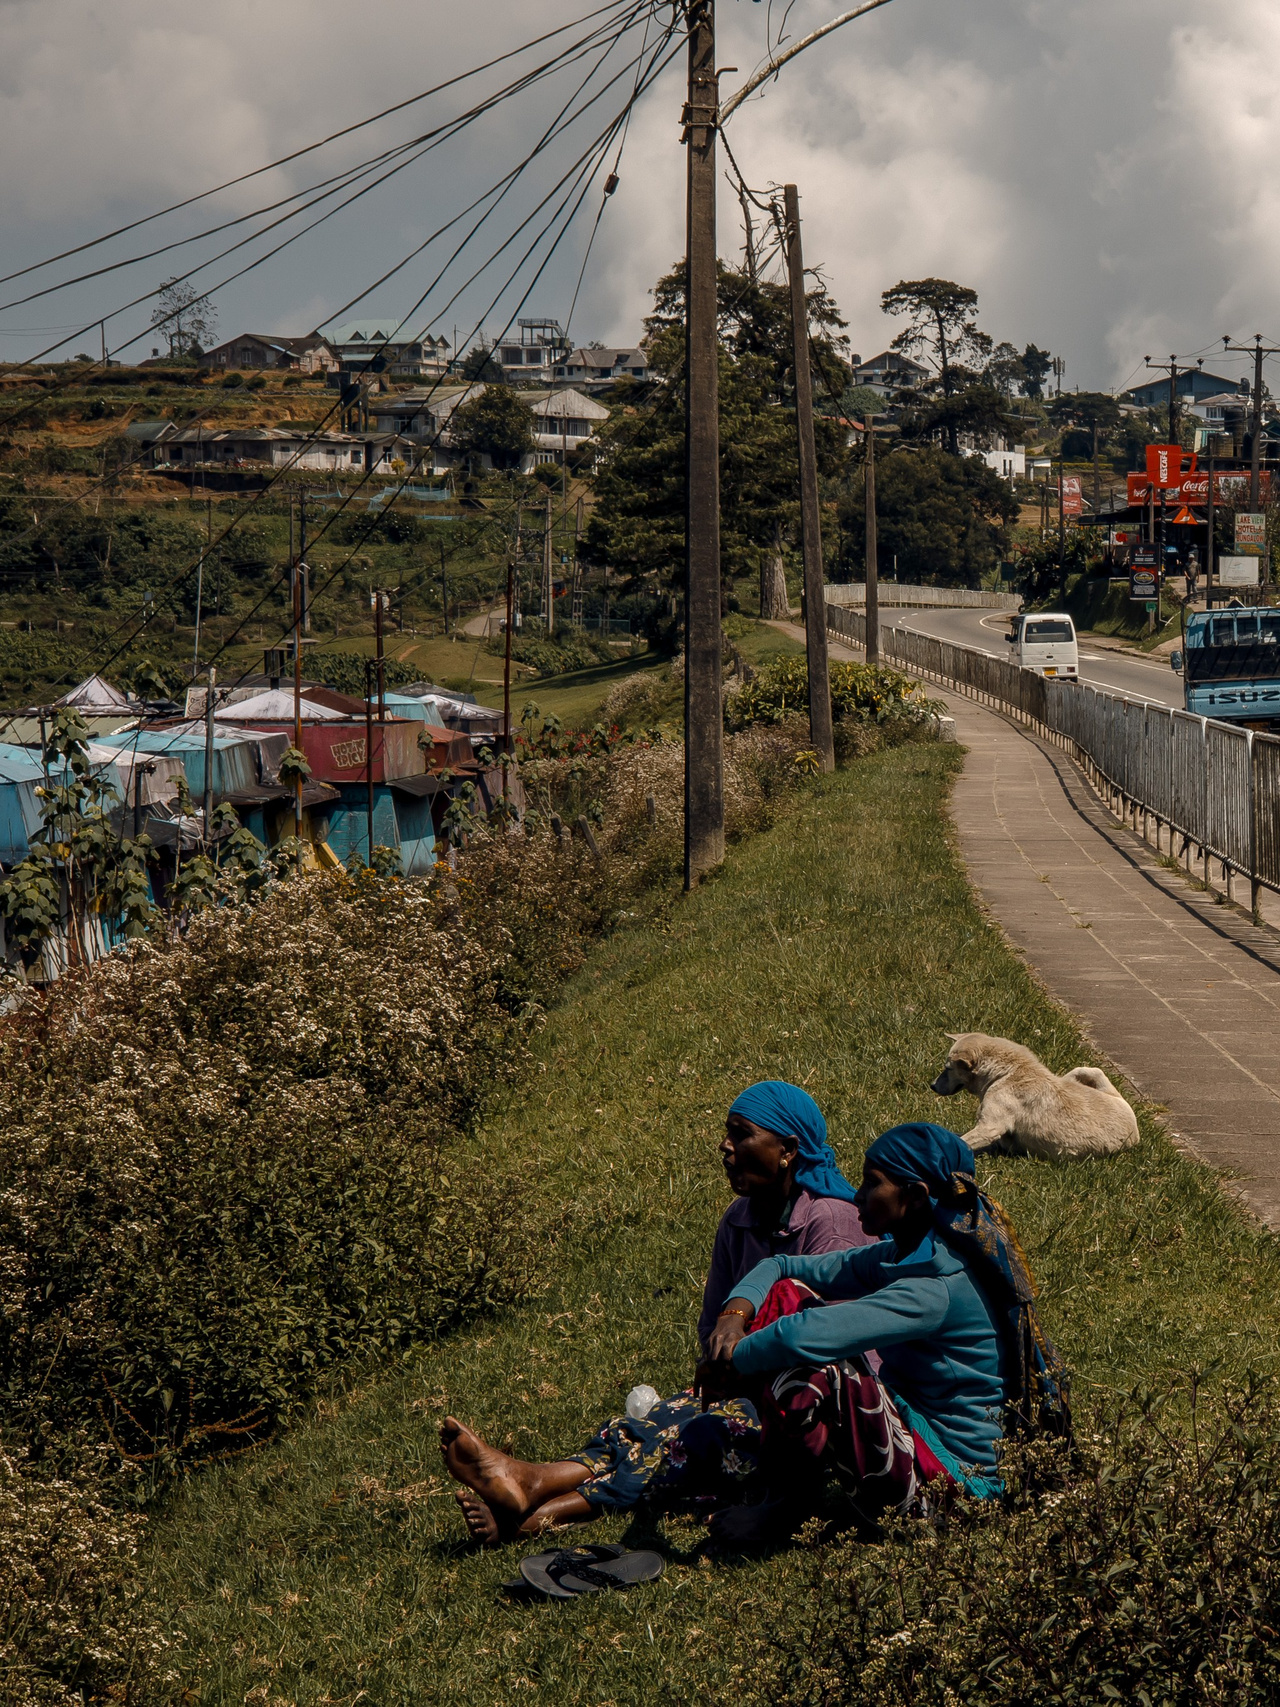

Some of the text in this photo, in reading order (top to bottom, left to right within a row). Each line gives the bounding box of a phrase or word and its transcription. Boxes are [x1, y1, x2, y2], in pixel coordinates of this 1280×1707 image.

[1158, 450, 1168, 483] NESCAFÉ
[1182, 480, 1213, 492] Coca-Co
[1236, 515, 1264, 524] LAKE VIEW
[1237, 525, 1257, 533] HOTEL
[1236, 534, 1264, 543] BUNGALOW
